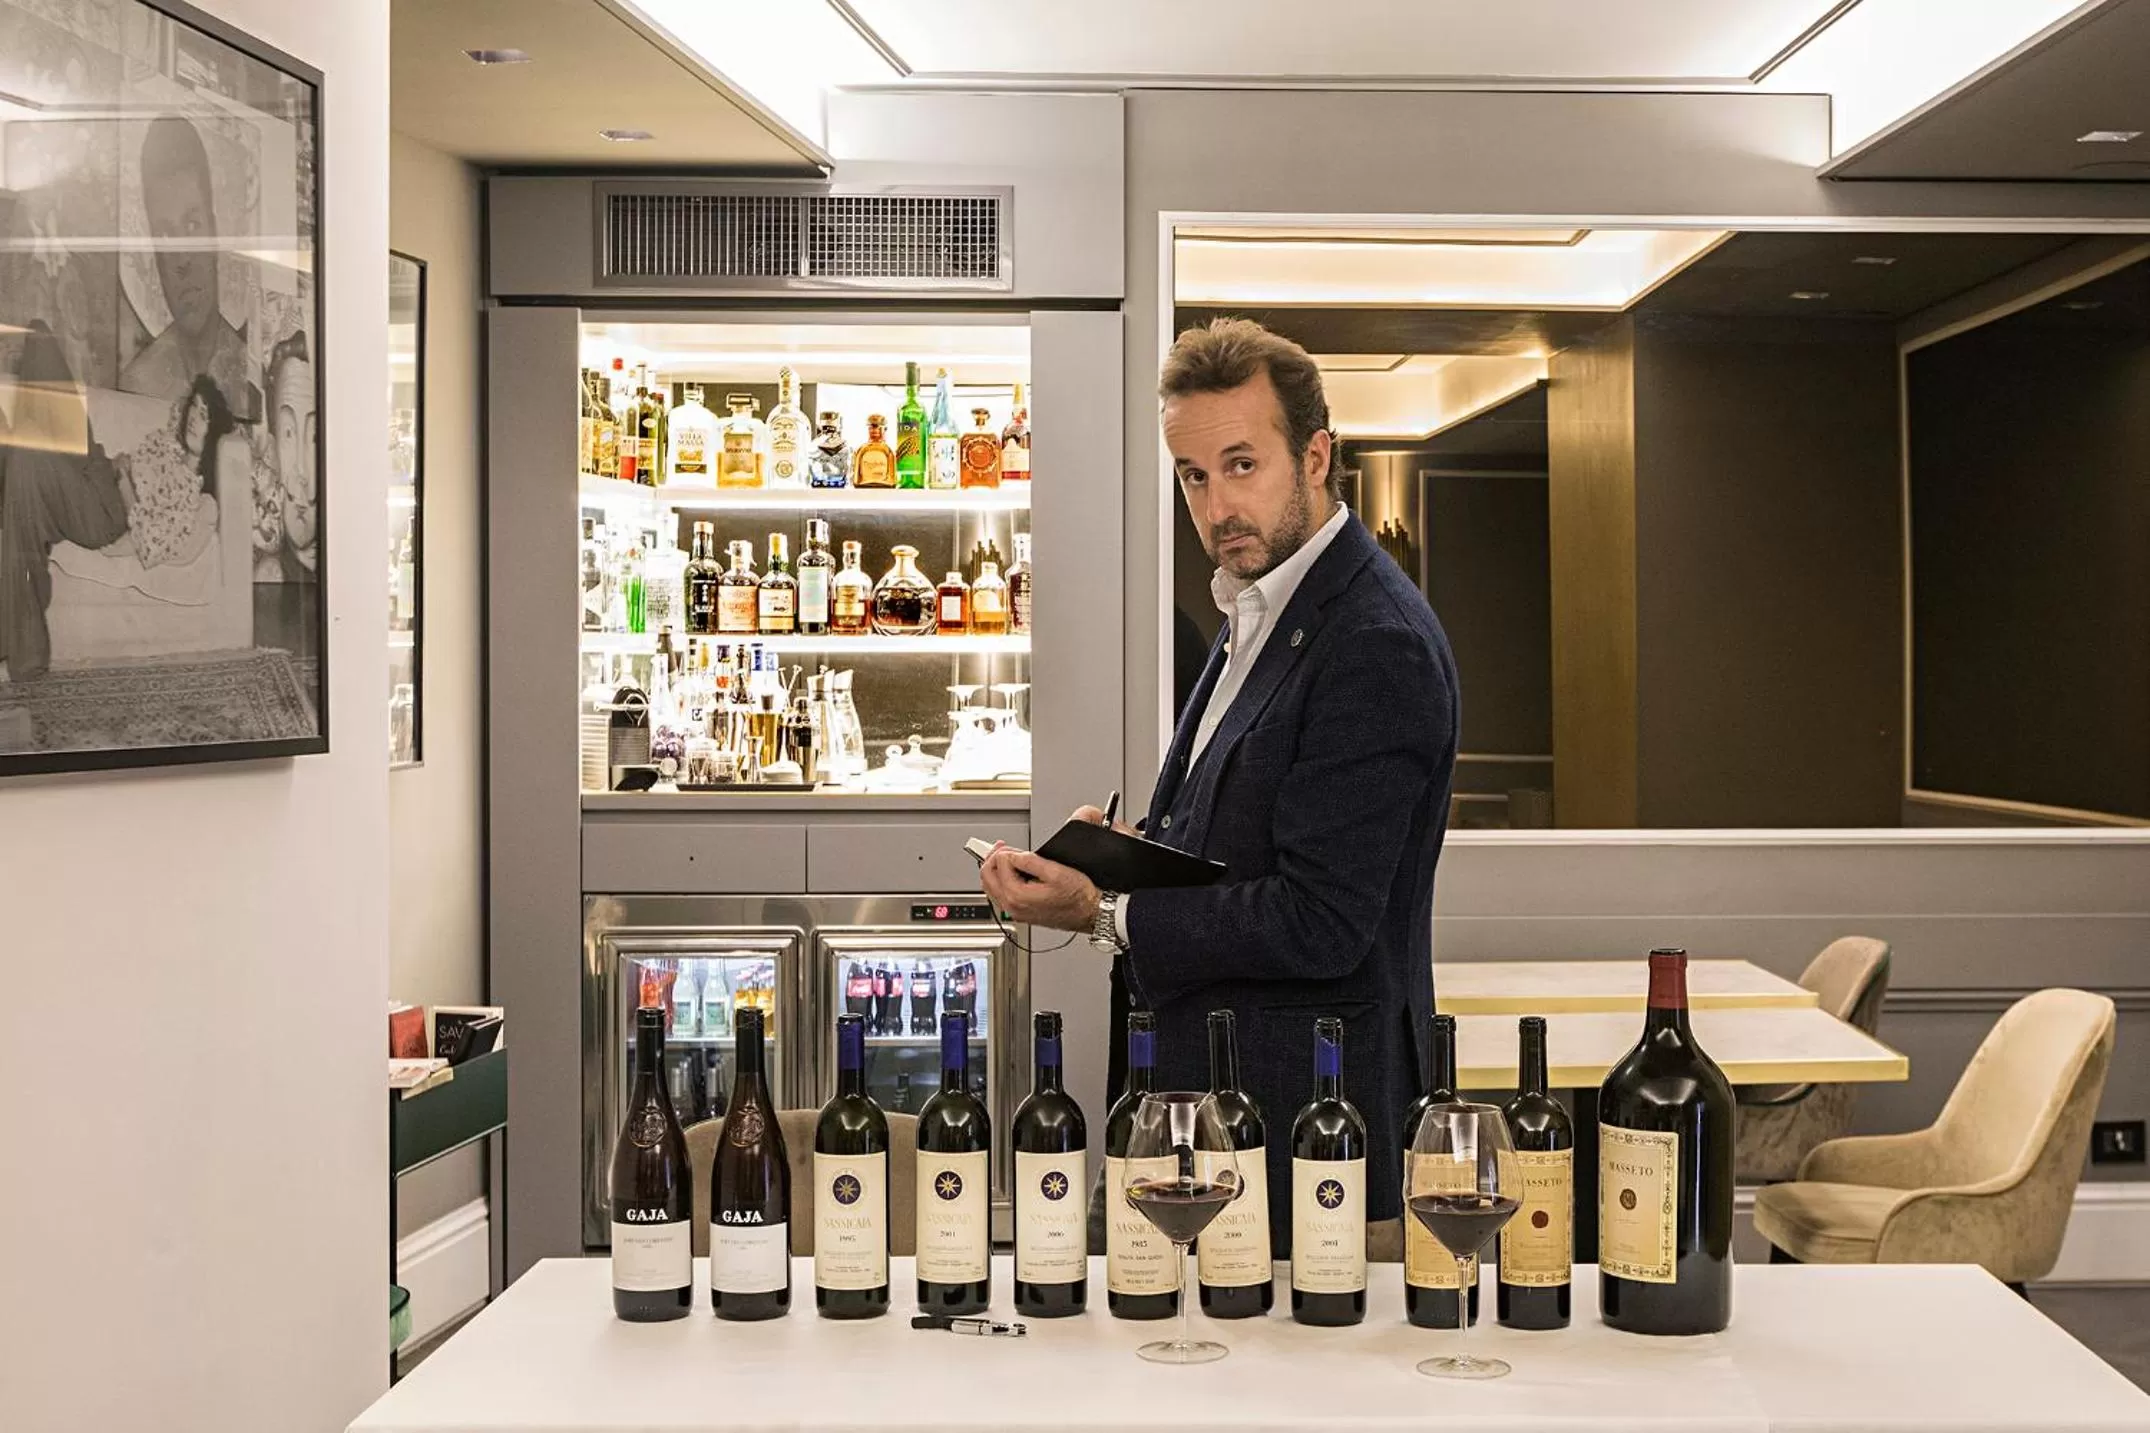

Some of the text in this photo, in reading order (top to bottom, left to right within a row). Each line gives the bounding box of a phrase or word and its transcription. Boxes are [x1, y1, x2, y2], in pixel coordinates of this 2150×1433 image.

[1608, 1161, 1654, 1177] MASSETO
[626, 1208, 669, 1221] GAJA
[722, 1210, 764, 1223] GAJA
